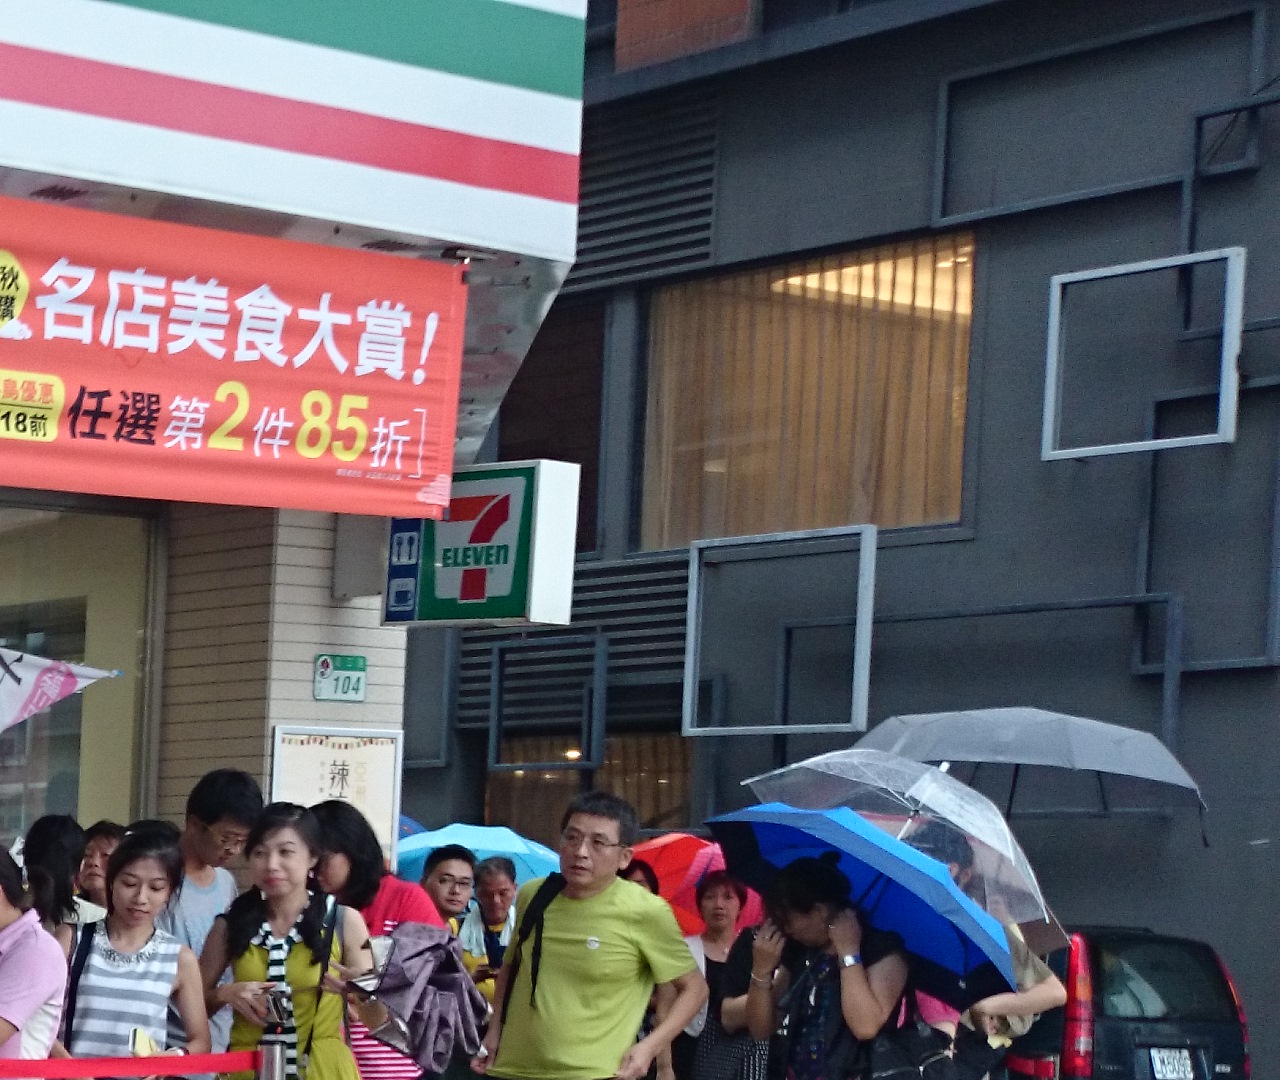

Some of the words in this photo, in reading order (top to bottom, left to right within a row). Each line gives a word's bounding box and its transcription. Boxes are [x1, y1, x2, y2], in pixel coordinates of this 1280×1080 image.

[36, 257, 438, 386] 名店美食大賞!
[332, 675, 362, 696] 104
